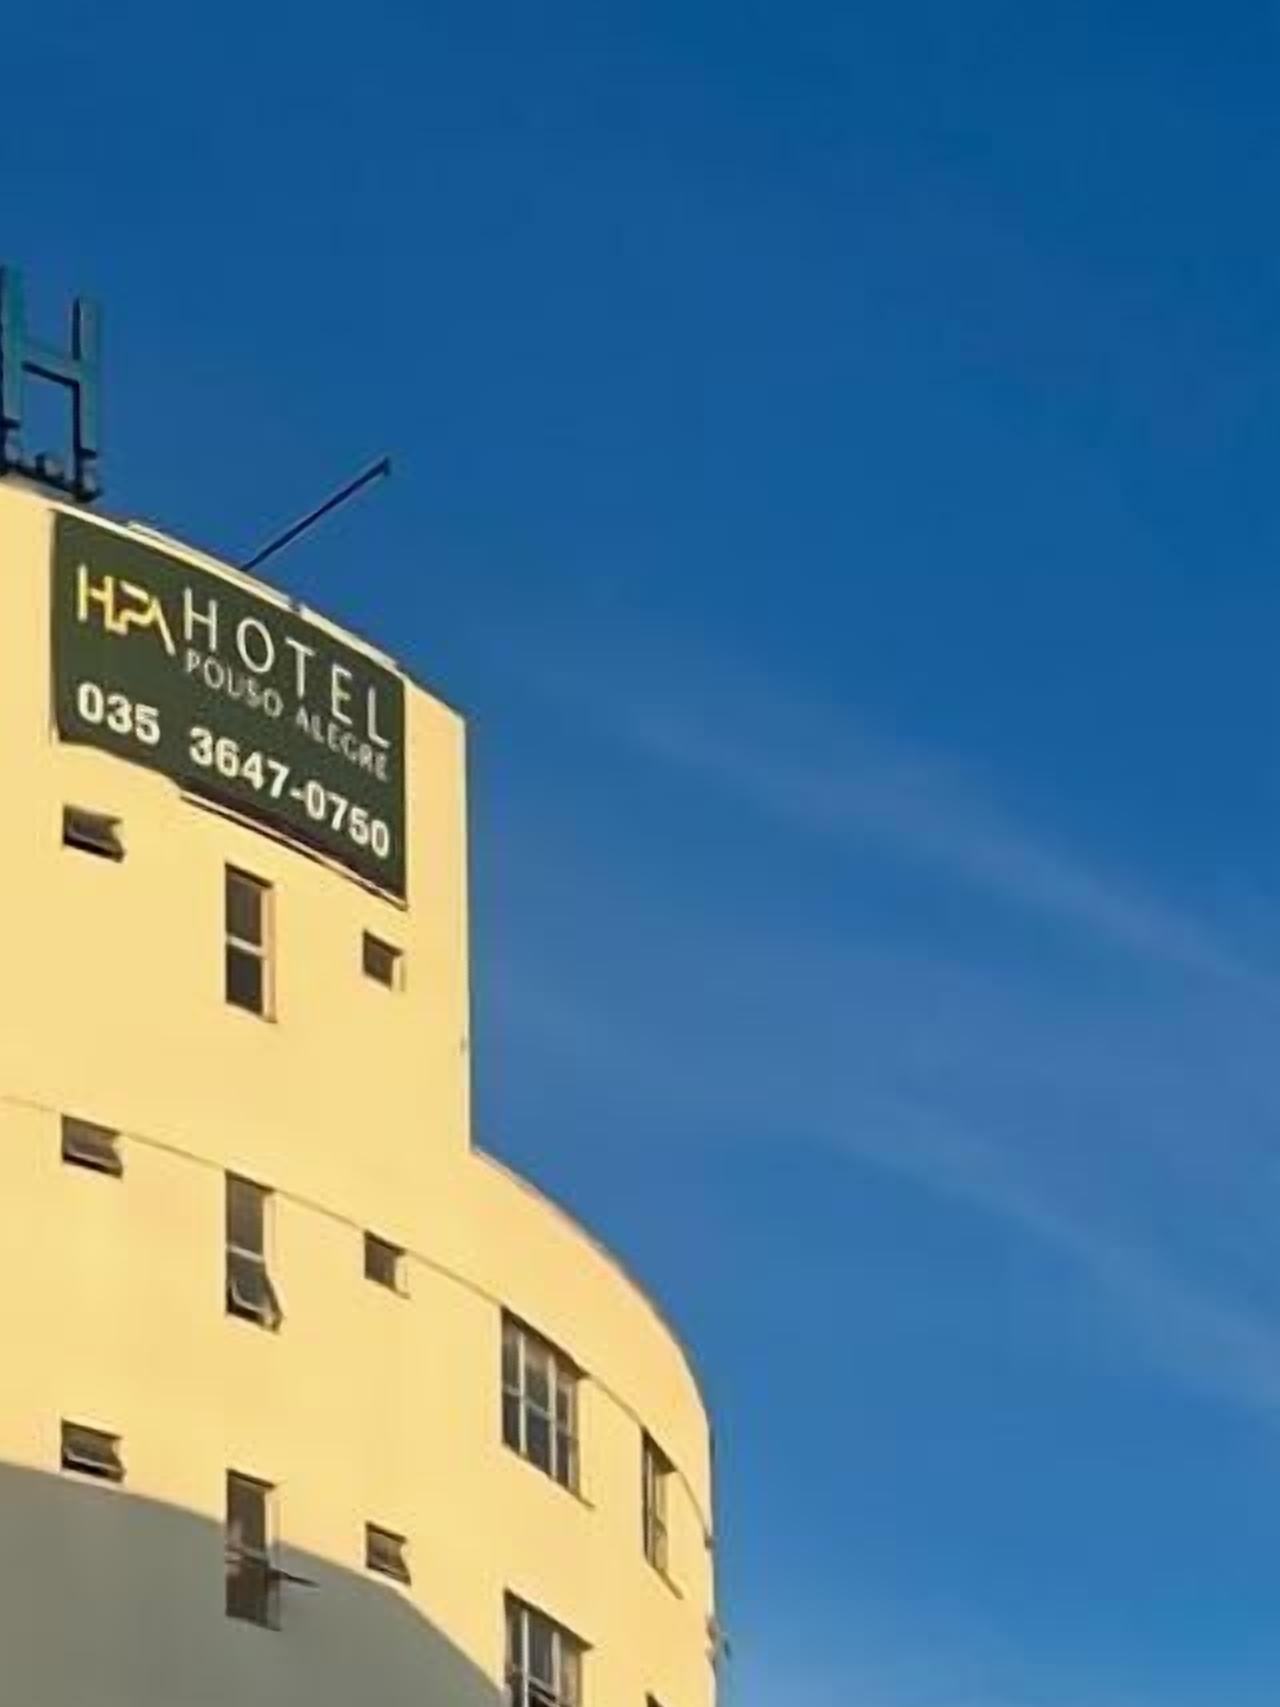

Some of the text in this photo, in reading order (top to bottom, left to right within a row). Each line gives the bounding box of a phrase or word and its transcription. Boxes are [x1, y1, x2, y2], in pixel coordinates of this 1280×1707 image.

[182, 586, 392, 749] HOTEL
[185, 647, 389, 783] POUSO ALEGRE
[76, 681, 392, 860] 035 3647-0750
